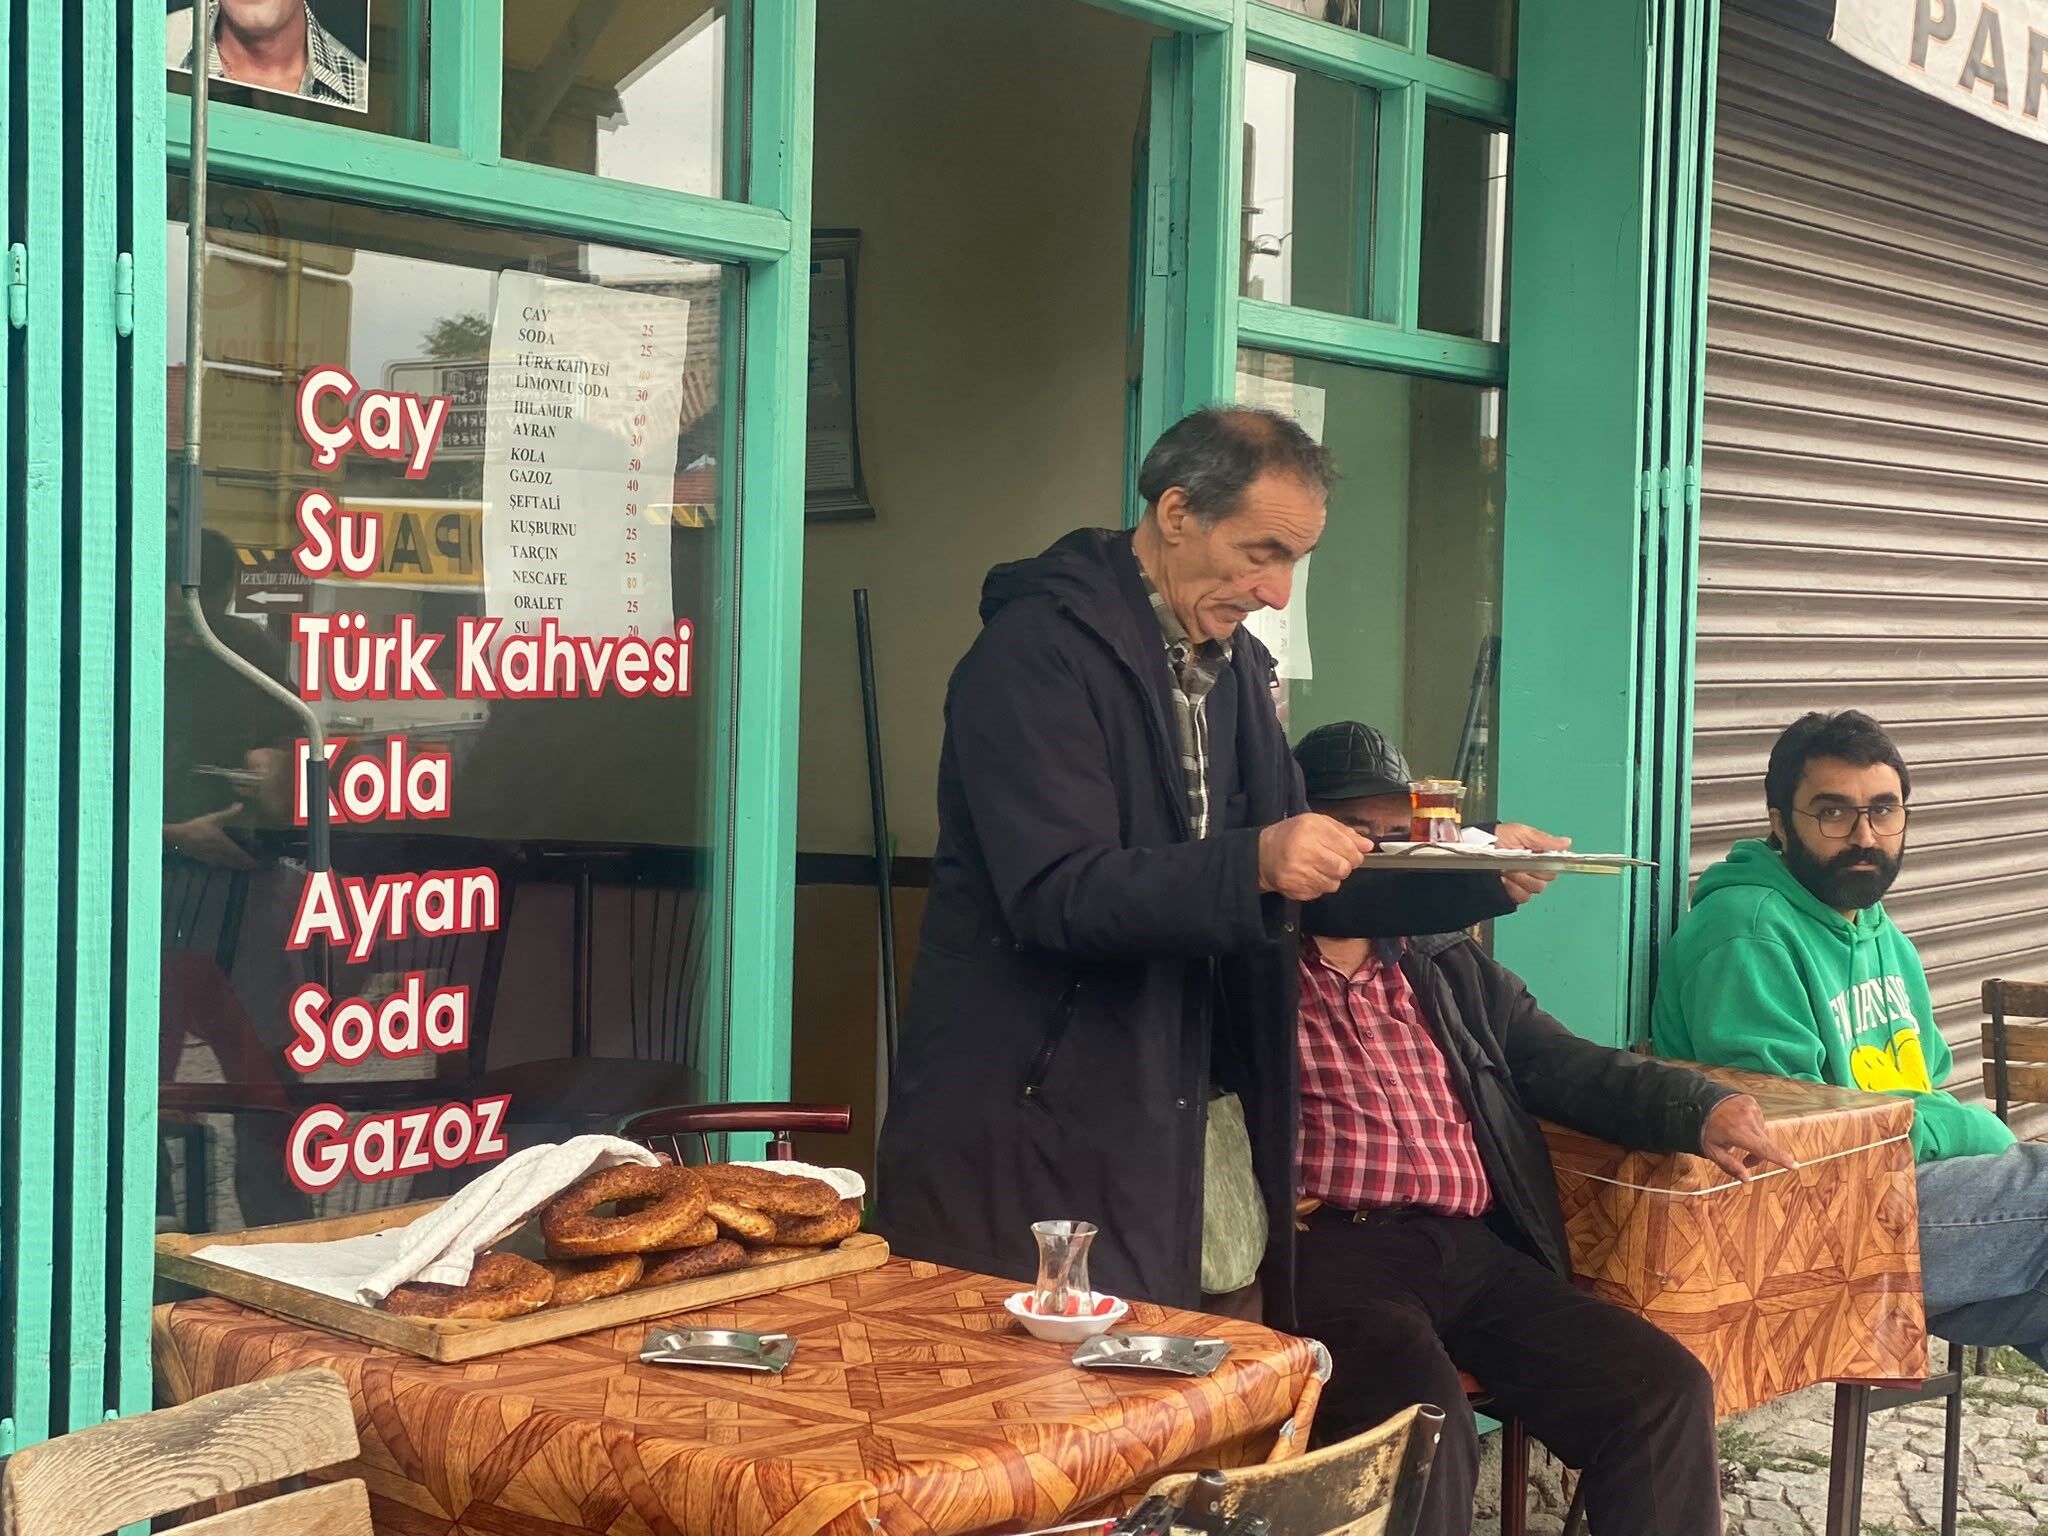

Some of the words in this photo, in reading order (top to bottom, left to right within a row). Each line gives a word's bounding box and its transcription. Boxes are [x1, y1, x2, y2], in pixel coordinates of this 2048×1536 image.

[522, 306, 551, 323] ÇAY
[642, 324, 655, 337] 25
[518, 328, 556, 345] SODA
[640, 345, 653, 358] 25
[516, 351, 553, 371] TÜRK
[556, 359, 611, 377] KAHVESİ
[515, 372, 575, 395] LİMONLU
[577, 384, 610, 399] SODA
[635, 389, 648, 402] 30
[296, 363, 452, 479] Çay
[513, 400, 574, 420] IHLAMUR
[634, 414, 646, 427] 60
[512, 422, 556, 439] AYRAN
[631, 435, 643, 448] 30
[510, 447, 546, 464] KOLA
[629, 459, 641, 472] 50
[509, 468, 553, 485] GAZOZ
[626, 479, 639, 492] 40
[509, 494, 561, 511] ŞEFTALİ
[625, 503, 638, 516] 50
[292, 487, 384, 580] Su
[510, 519, 577, 537] KUŞBURNU
[626, 527, 638, 541] 25
[510, 545, 559, 563] TARÇIN
[625, 552, 637, 565] 25
[512, 569, 568, 586] NESCAFE
[514, 595, 563, 611] ORALET
[626, 601, 639, 613] 25
[514, 620, 530, 635] SU
[628, 624, 640, 637] 20
[292, 611, 448, 701] Türk
[455, 613, 694, 700] Kahvesi
[285, 866, 500, 964] Ayran
[284, 971, 470, 1074] Soda
[285, 1093, 513, 1194] Gazoz
